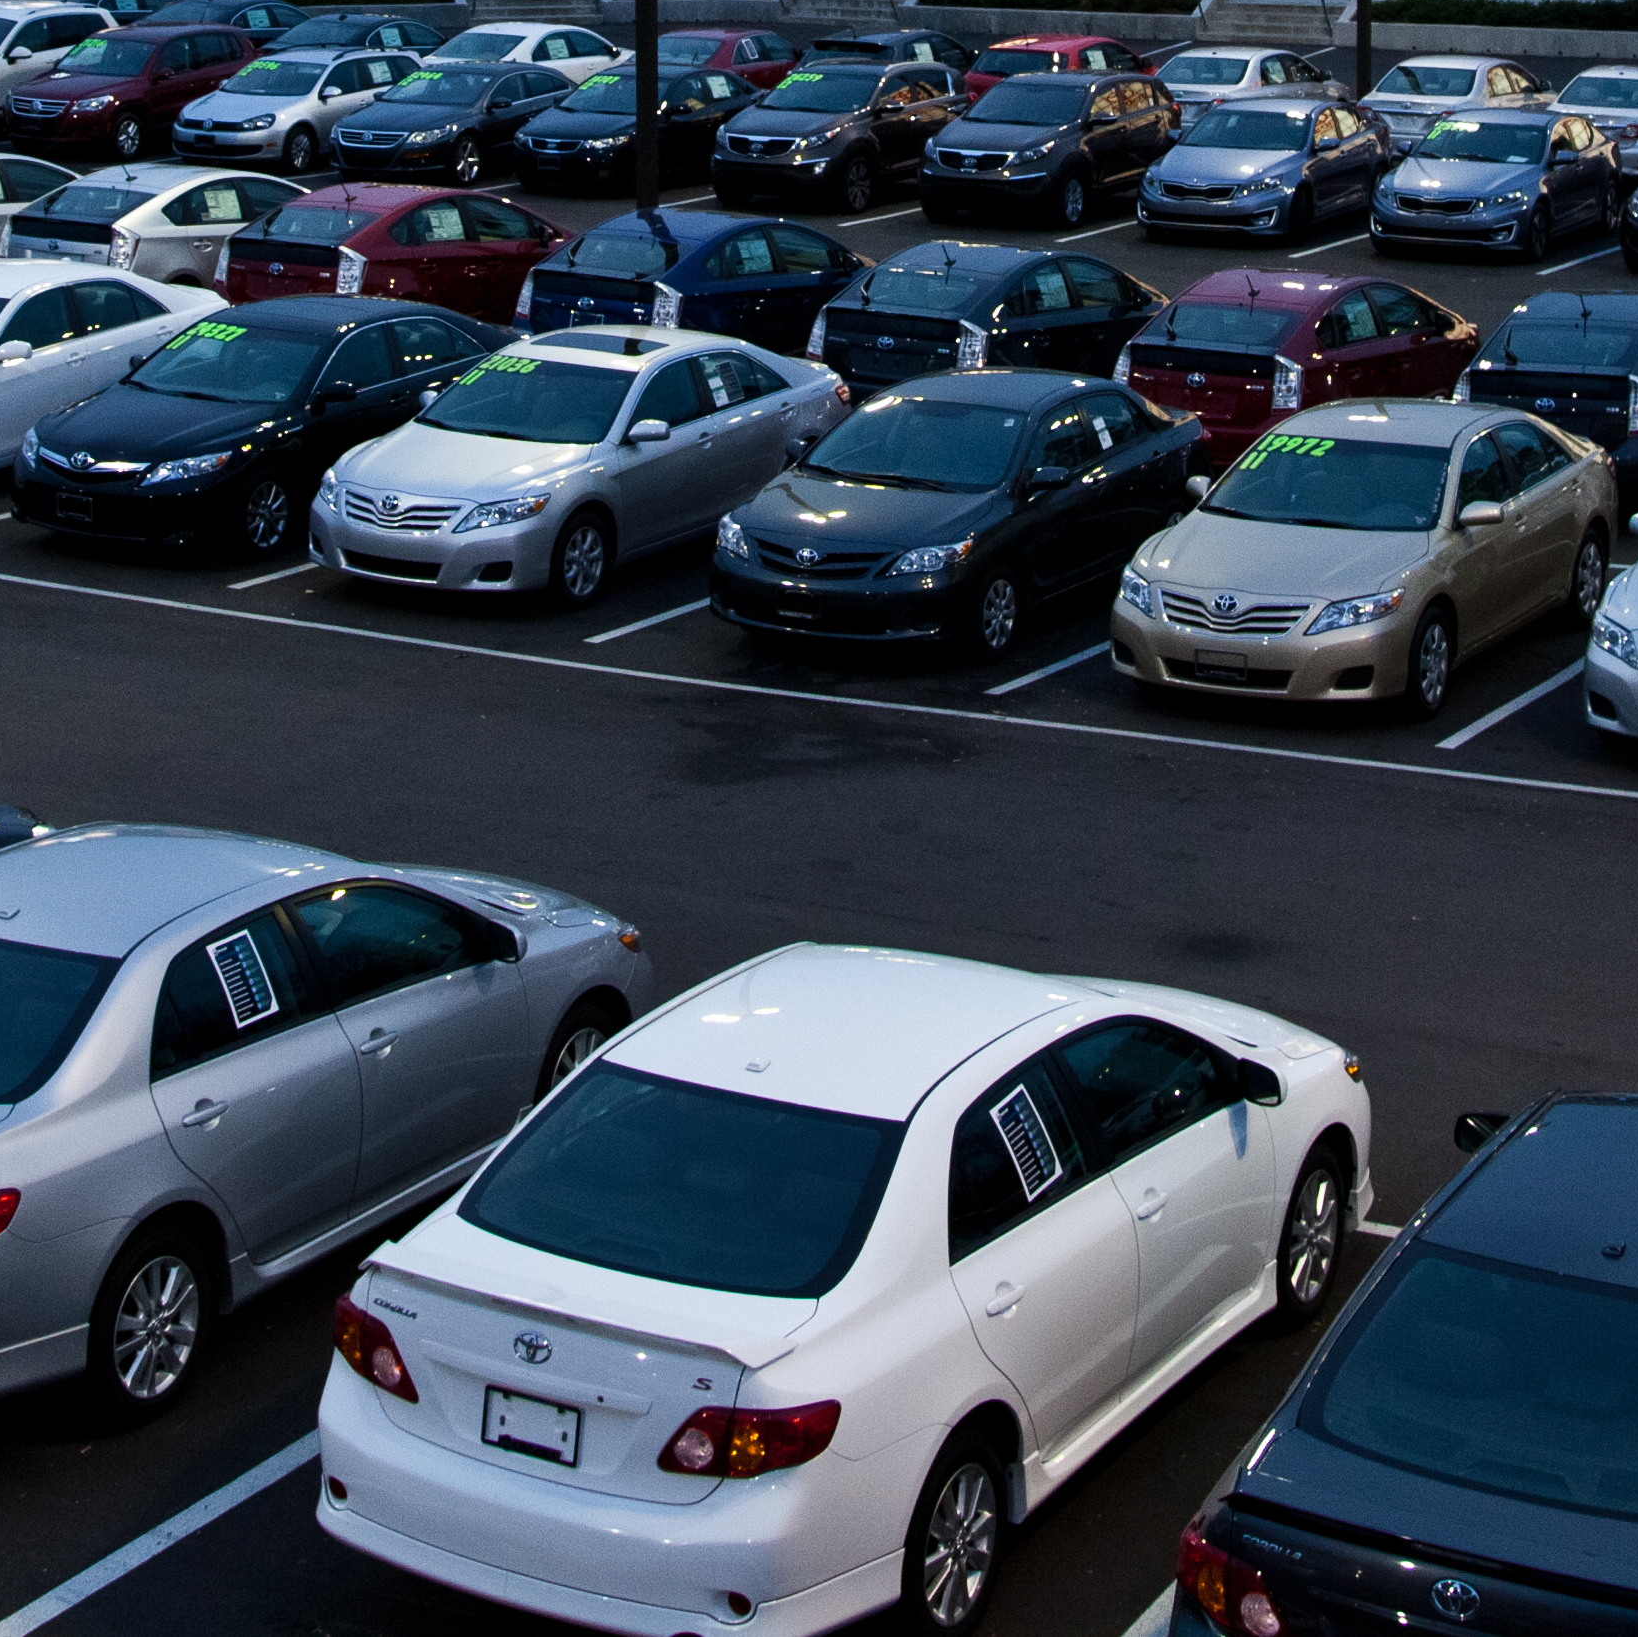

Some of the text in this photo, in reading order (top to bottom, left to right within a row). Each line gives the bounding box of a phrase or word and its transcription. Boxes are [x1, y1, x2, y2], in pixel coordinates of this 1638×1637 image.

[186, 321, 248, 343] 24327
[479, 354, 542, 374] 21036
[458, 369, 486, 386] 11
[1257, 433, 1336, 458] 19972
[1239, 451, 1268, 470] 11
